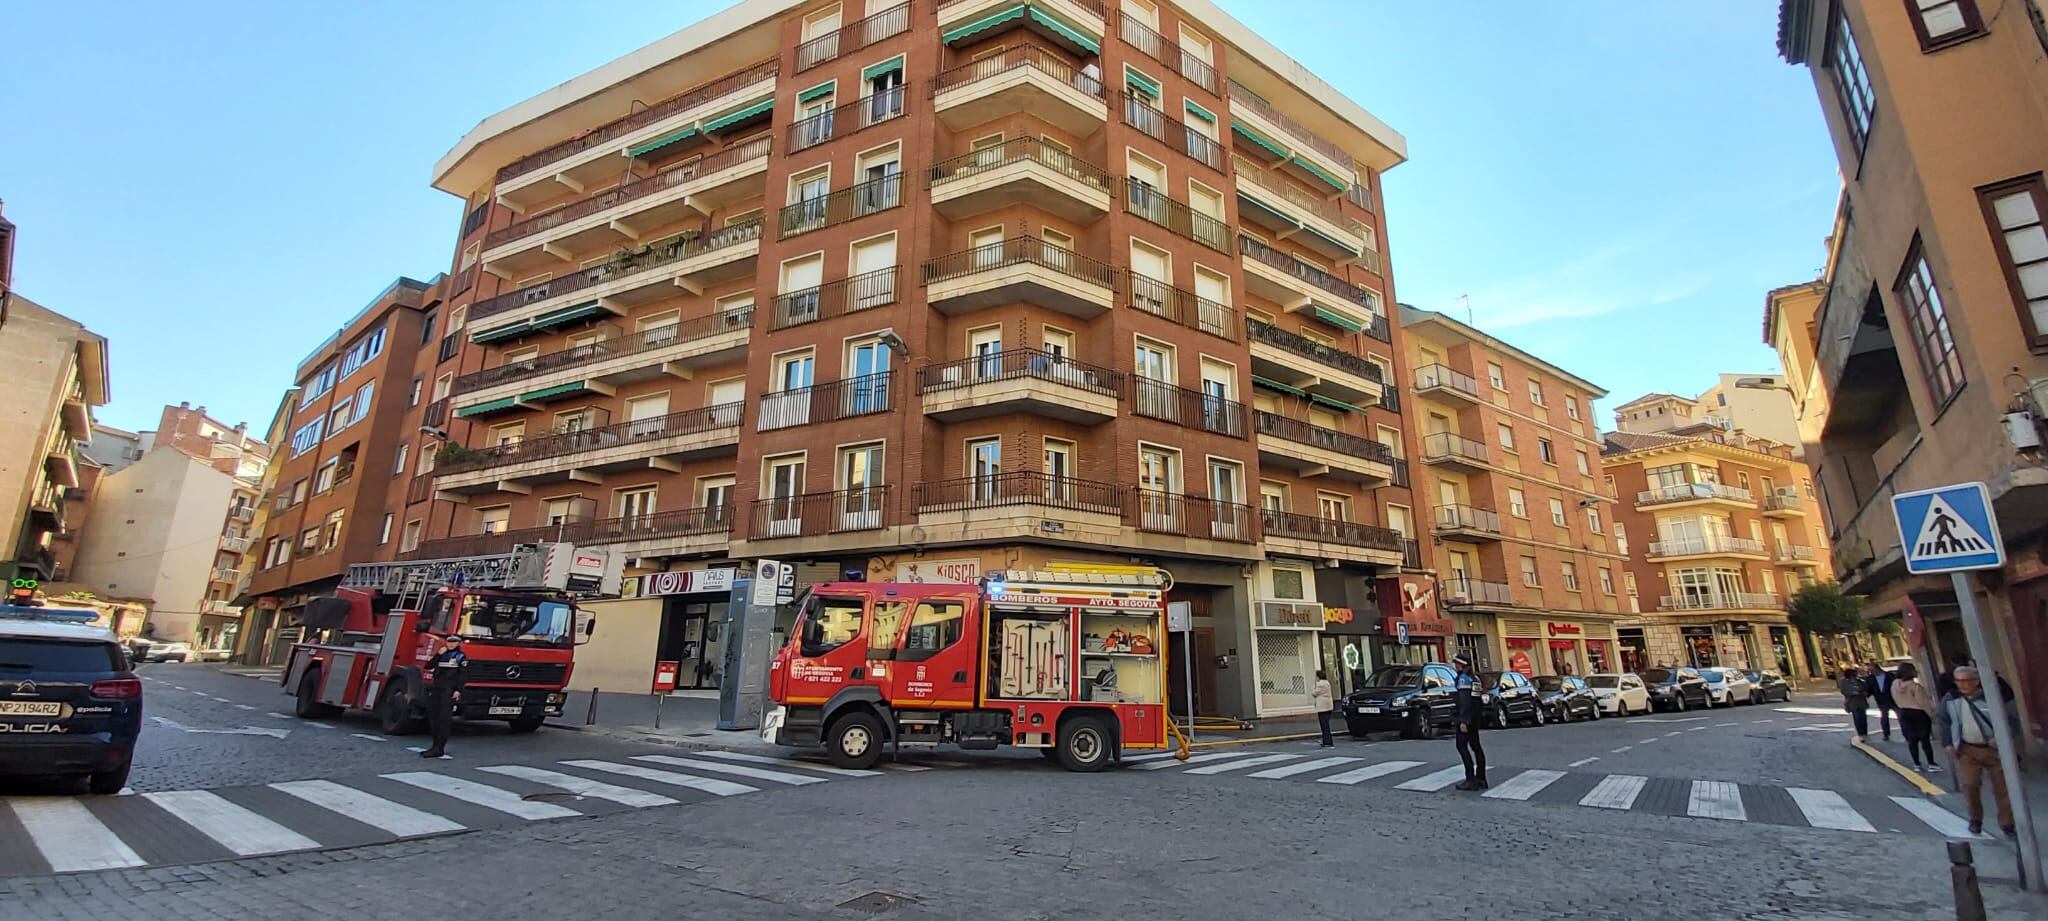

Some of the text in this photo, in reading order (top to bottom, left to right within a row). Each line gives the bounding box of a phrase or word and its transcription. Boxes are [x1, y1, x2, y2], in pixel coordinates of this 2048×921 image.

[991, 594, 1058, 604] BOMBEROS
[1089, 598, 1159, 608] AYTO. SEGOVIA
